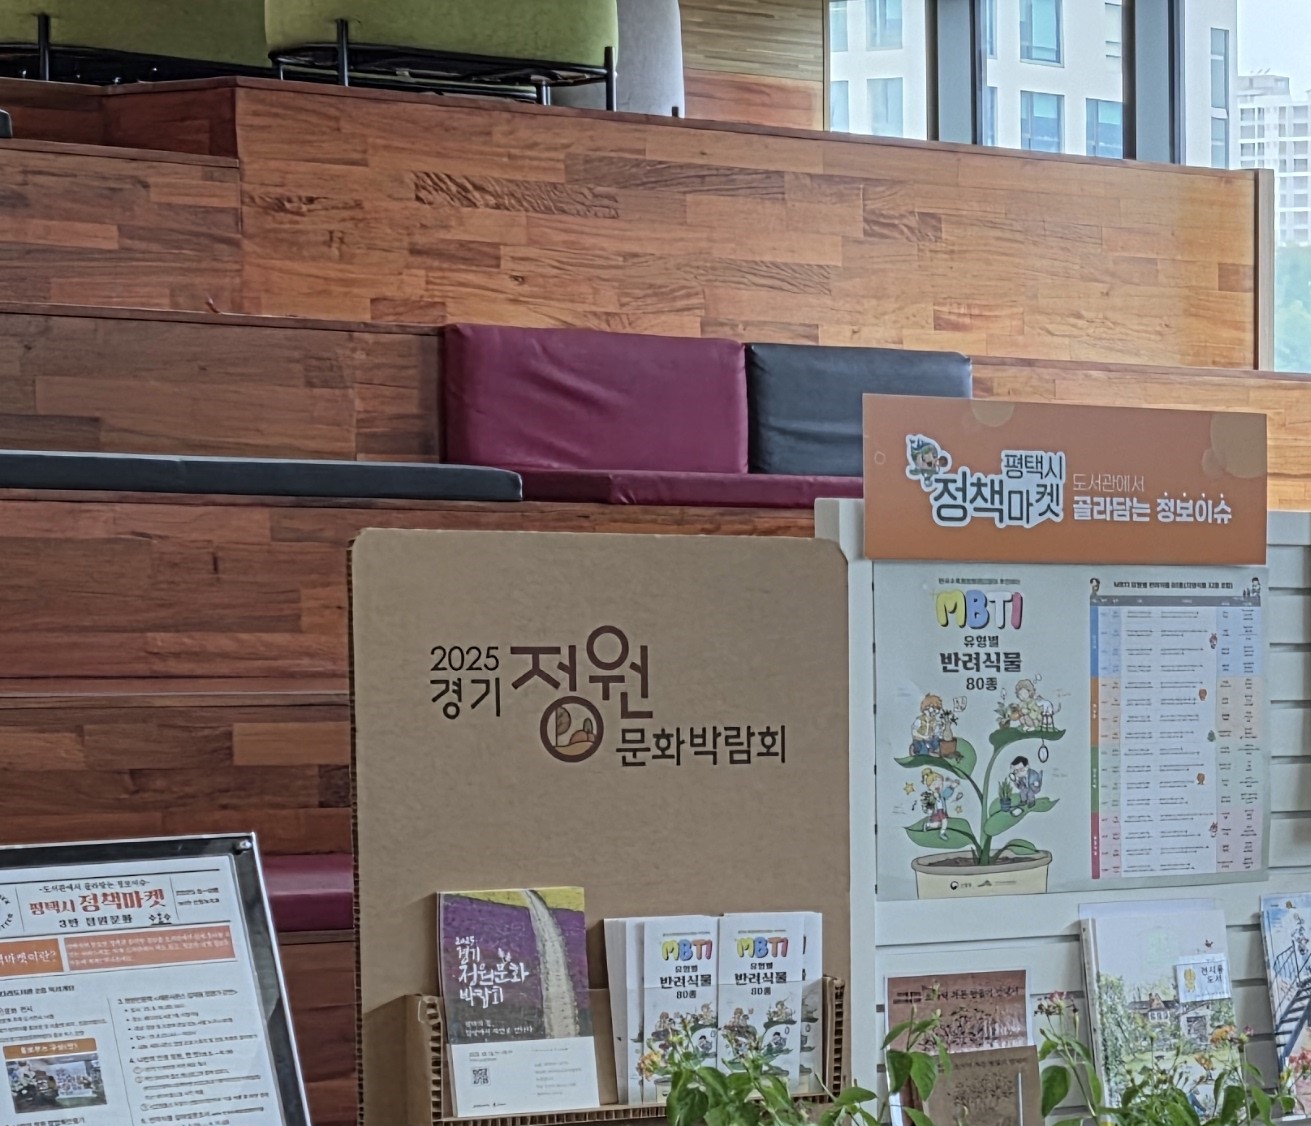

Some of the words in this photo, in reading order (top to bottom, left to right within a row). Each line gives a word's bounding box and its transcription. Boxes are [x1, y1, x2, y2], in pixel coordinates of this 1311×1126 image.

[1004, 453, 1064, 480] 평택시
[1073, 473, 1145, 493] 도서관에서
[934, 471, 1062, 525] 정책마켓
[1073, 497, 1150, 522] 골라담는
[1157, 493, 1232, 524] 정보이슈
[935, 589, 1023, 629] MBTI
[963, 635, 1000, 648] 유형별
[430, 646, 499, 671] 2025
[939, 652, 1022, 673] 반려식물
[510, 625, 654, 763] 정원
[965, 677, 998, 691] 80종
[430, 677, 500, 719] 경기
[616, 725, 786, 766] 문화박람회
[29, 899, 76, 916] 평택시
[78, 888, 167, 913] 정책마켓
[0, 949, 57, 965] 마켓이란?
[661, 938, 713, 961] MBTI
[737, 936, 789, 959] MBTI
[458, 962, 530, 986] 정원문화
[660, 974, 712, 989] 반려식물
[735, 971, 787, 986] 반려식물
